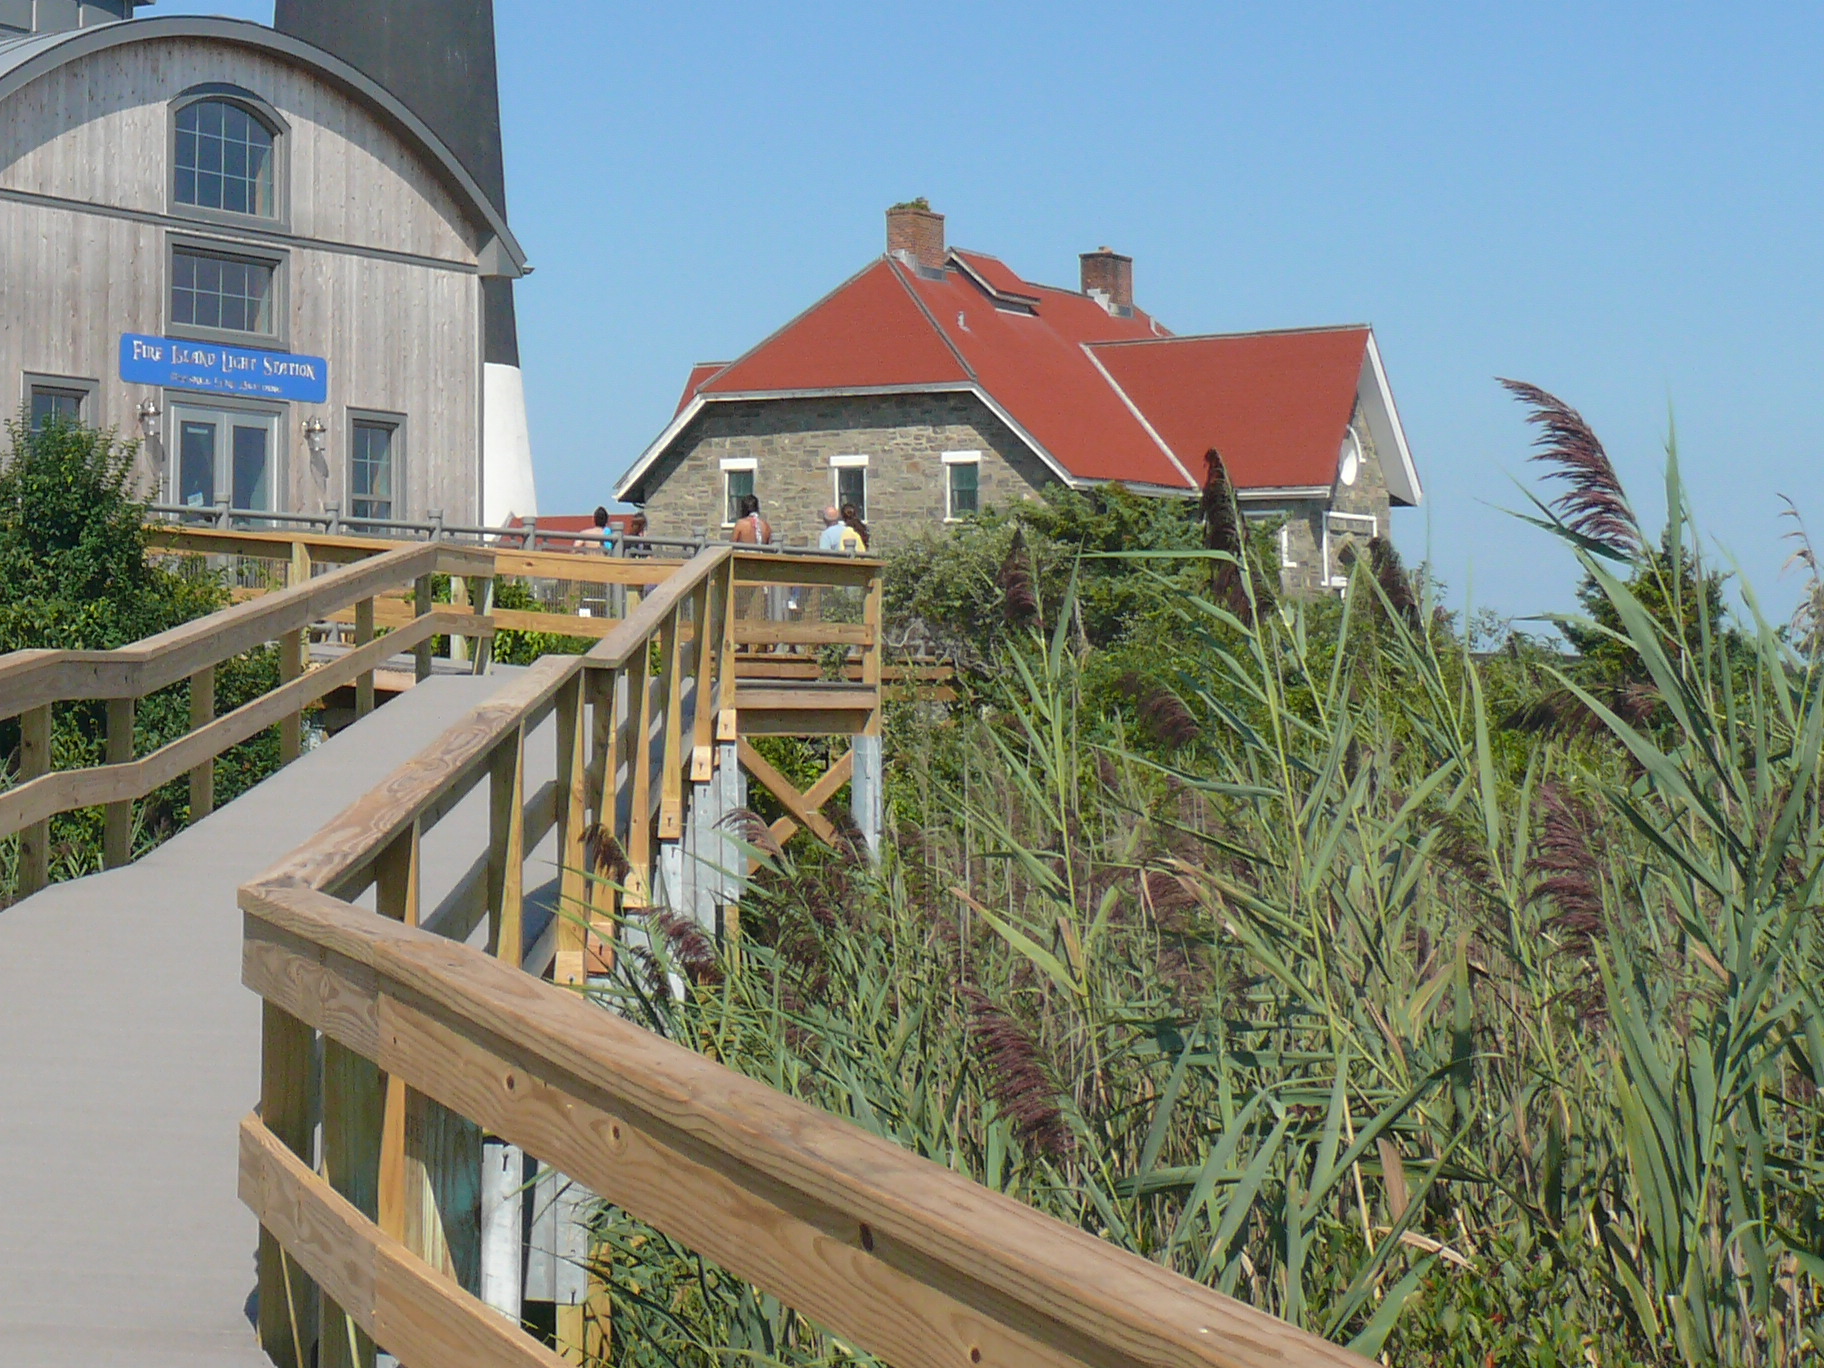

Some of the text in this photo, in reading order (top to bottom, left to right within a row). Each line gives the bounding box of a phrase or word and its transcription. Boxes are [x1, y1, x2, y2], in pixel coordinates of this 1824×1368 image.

[132, 340, 163, 362] FIRE
[221, 351, 257, 373] LIGHT
[263, 357, 316, 380] STATION
